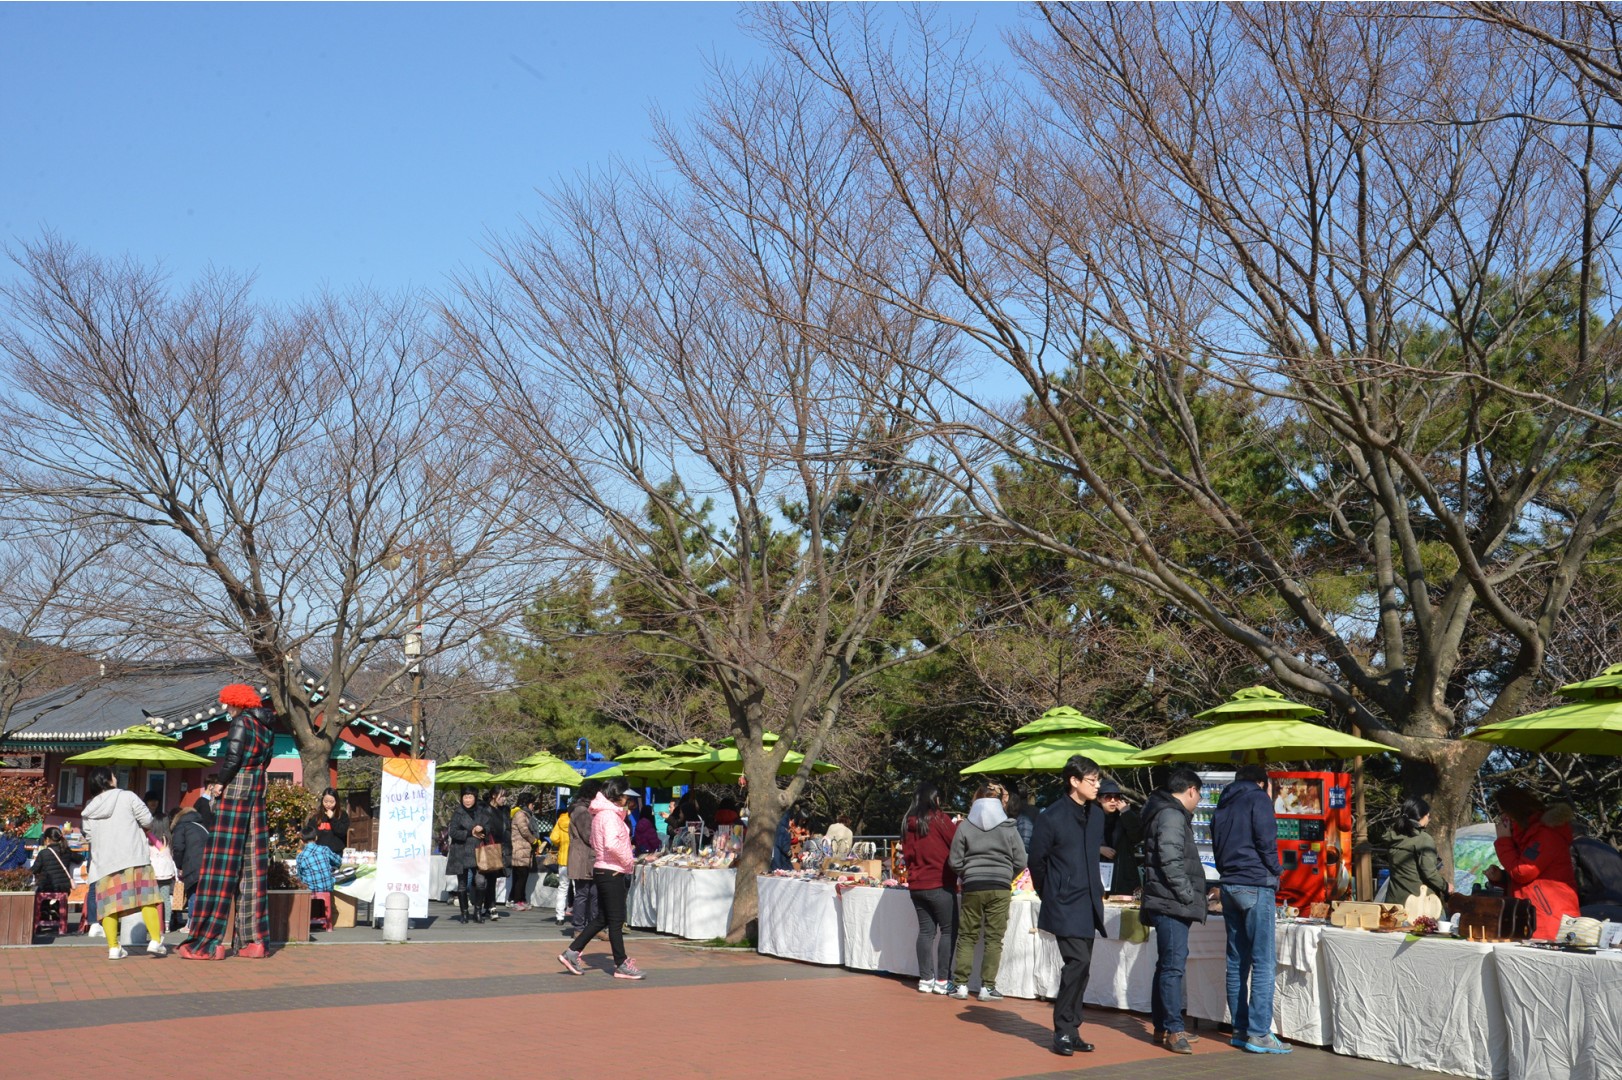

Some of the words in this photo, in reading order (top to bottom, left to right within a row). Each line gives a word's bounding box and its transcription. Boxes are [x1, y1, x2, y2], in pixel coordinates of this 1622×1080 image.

[386, 793, 402, 803] YOU
[404, 792, 409, 800] &
[389, 806, 426, 822] 자화상
[398, 829, 416, 843] 함께
[392, 844, 426, 859] 그리기
